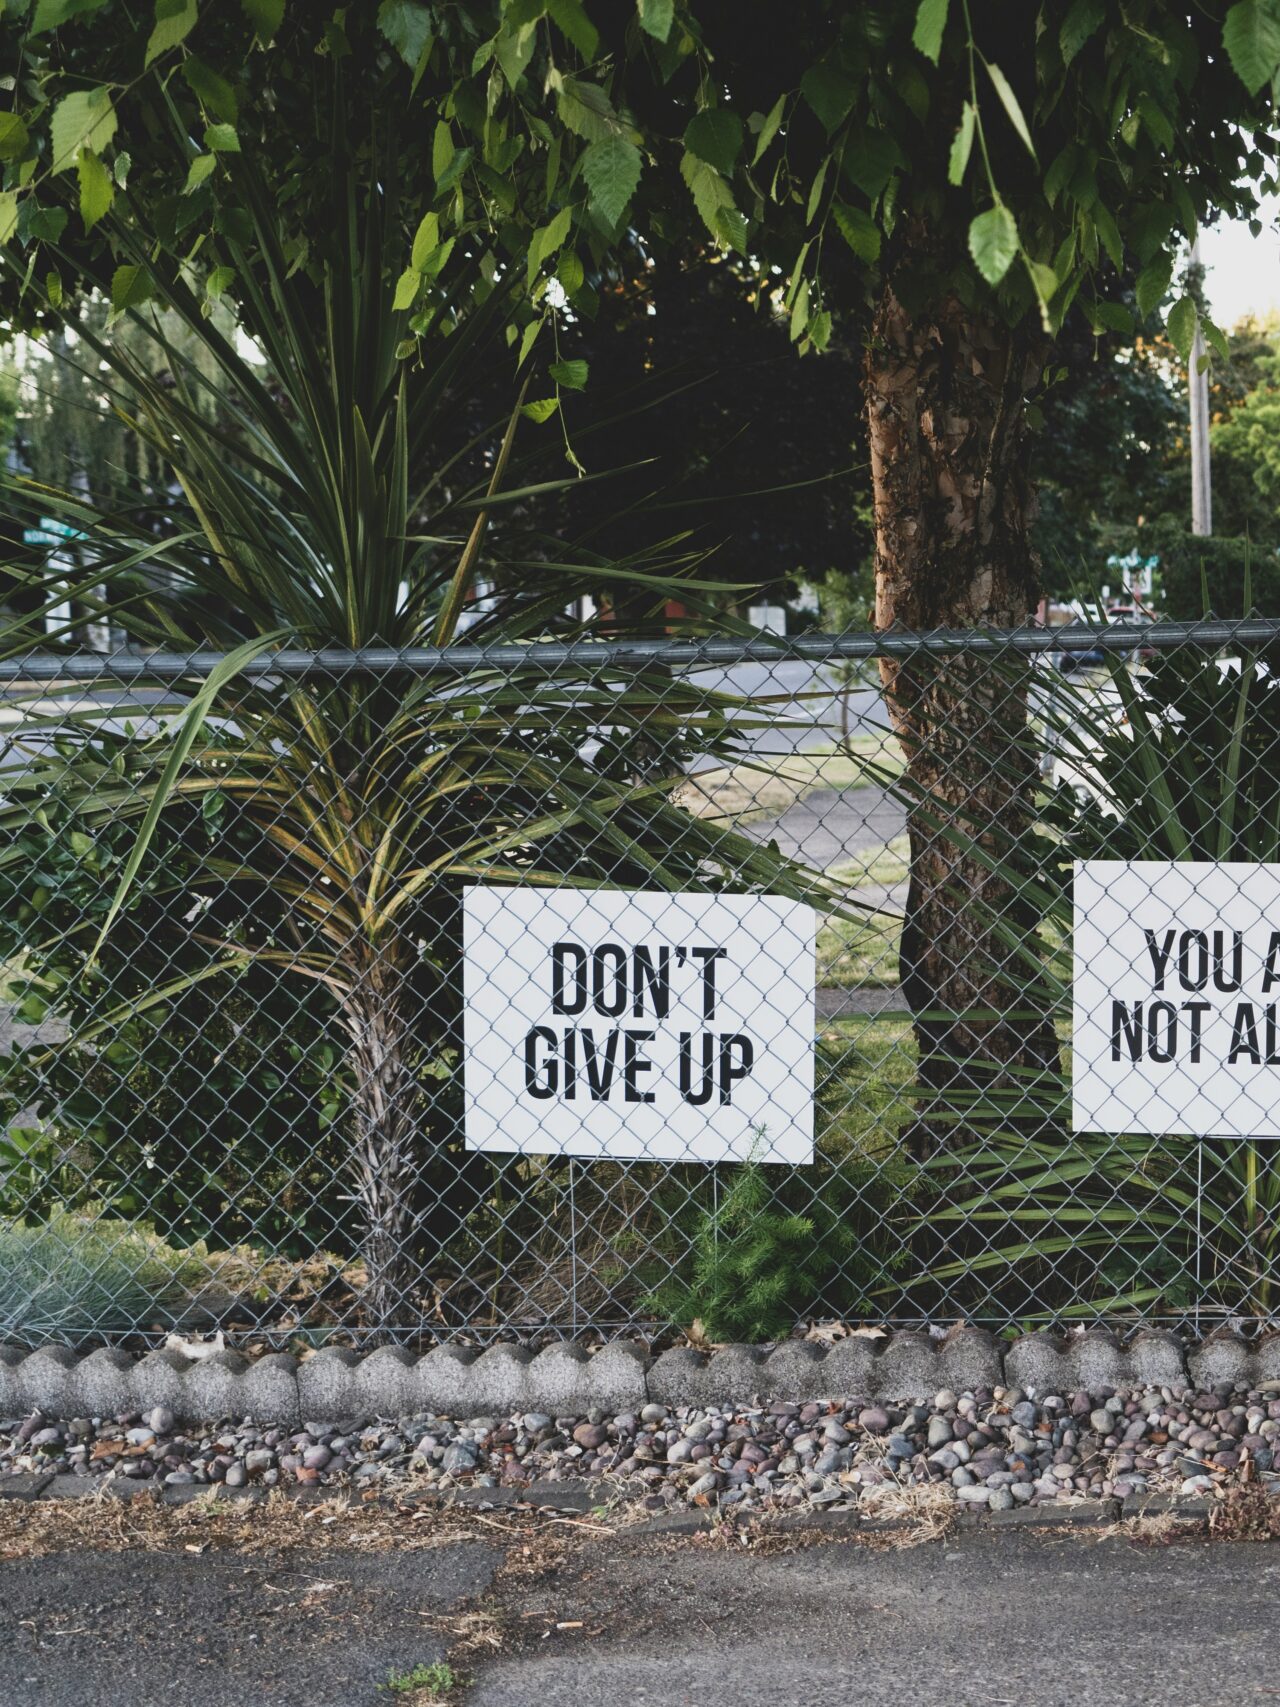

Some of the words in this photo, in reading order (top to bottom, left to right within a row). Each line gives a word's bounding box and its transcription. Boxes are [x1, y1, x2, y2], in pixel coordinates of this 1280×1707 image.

[552, 942, 727, 1020] DON'T
[1144, 929, 1243, 993] YOU
[525, 1026, 655, 1103] GIVE
[679, 1032, 754, 1106] UP
[1111, 1000, 1212, 1064] NOT
